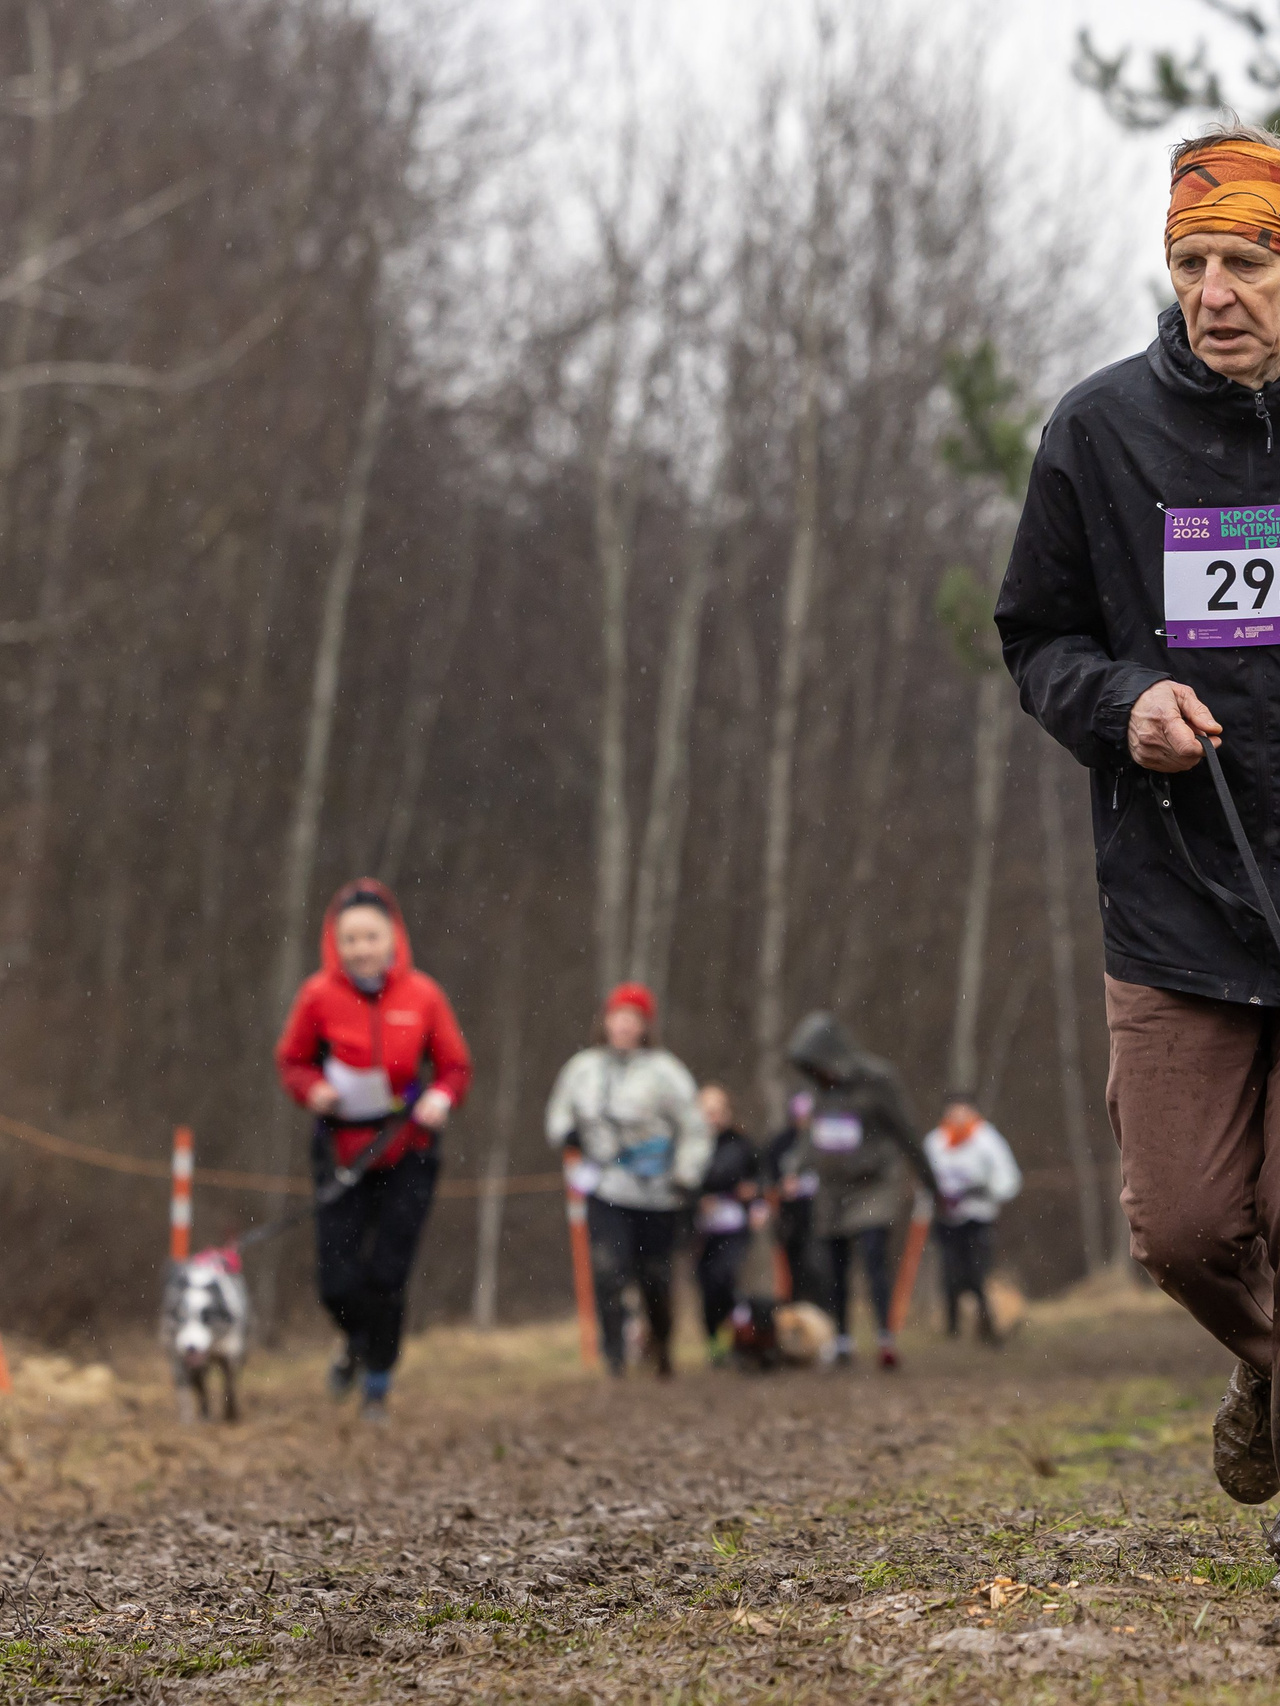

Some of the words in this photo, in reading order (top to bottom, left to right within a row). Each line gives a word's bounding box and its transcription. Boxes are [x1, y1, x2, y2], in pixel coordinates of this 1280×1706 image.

[1172, 516, 1210, 527] 11/04
[1220, 508, 1275, 524] КРОСС
[1172, 528, 1210, 539] 2026
